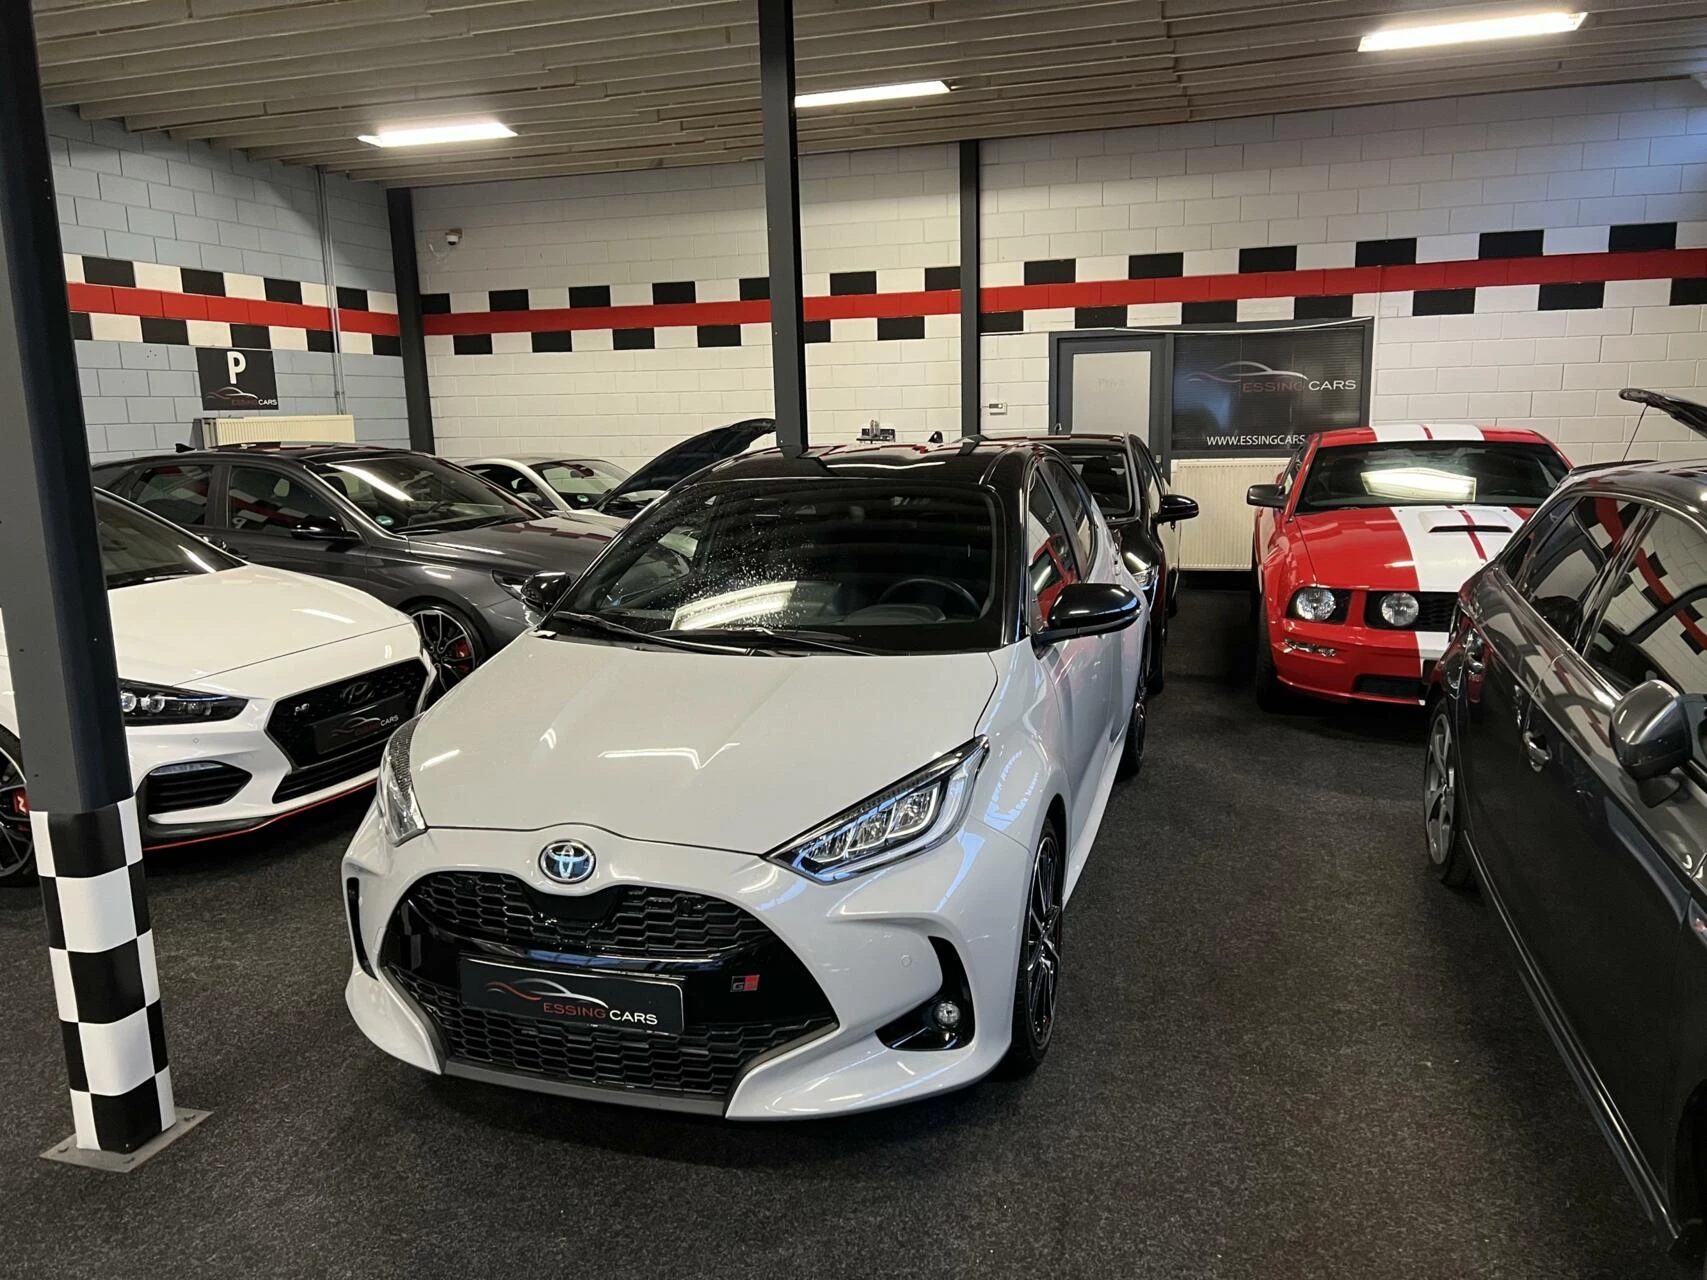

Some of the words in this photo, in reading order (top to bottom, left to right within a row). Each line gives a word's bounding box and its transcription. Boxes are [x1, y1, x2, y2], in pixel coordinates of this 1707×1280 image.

[226, 351, 247, 385] P
[1242, 382, 1304, 393] ESSING
[1308, 380, 1357, 391] CARS
[1206, 434, 1305, 446] WWW.ESSINGCARS
[380, 714, 399, 727] CARS
[543, 1002, 607, 1019] ESSING
[609, 1009, 658, 1025] CARS
